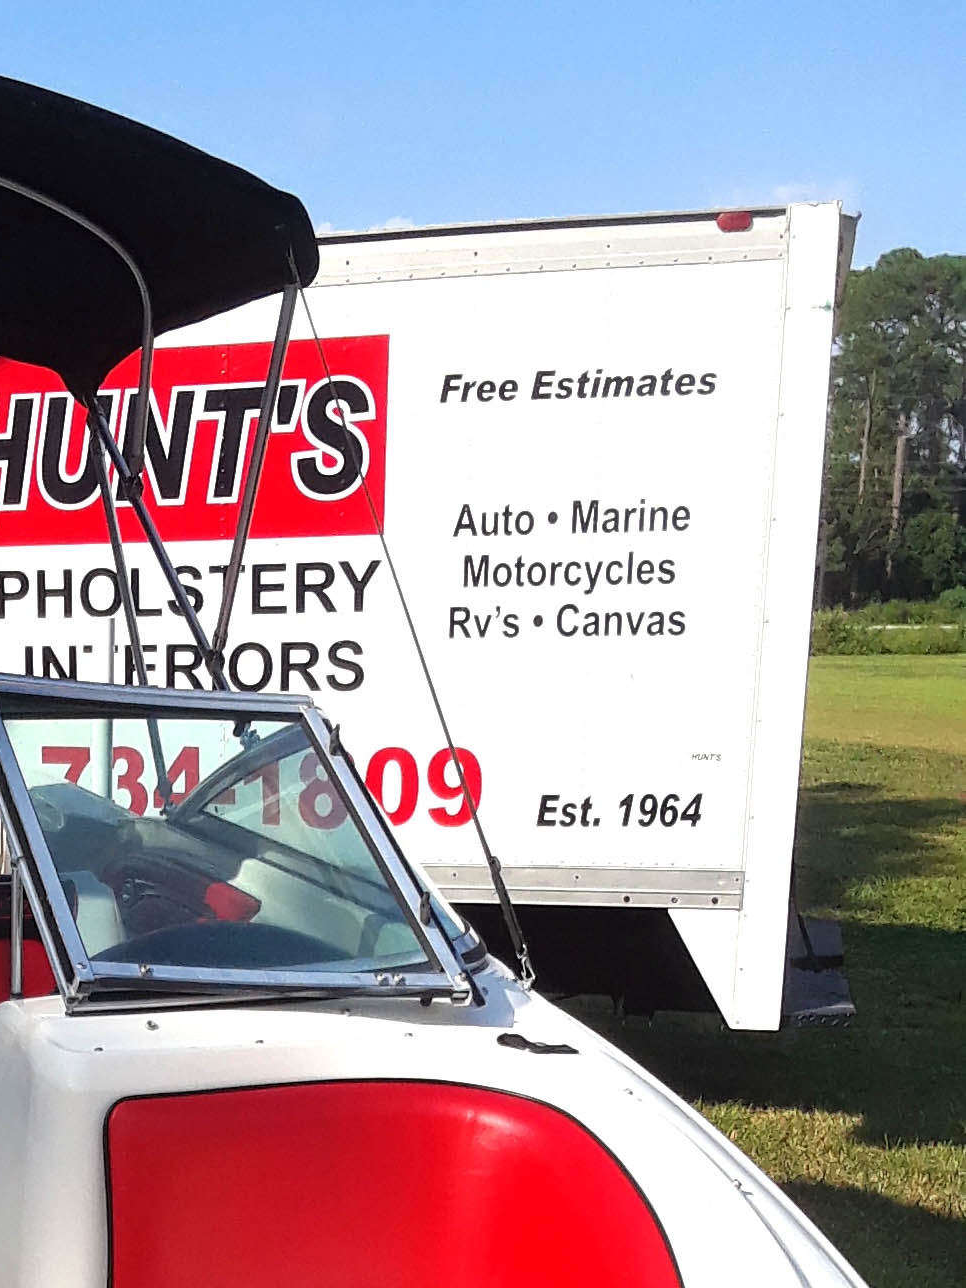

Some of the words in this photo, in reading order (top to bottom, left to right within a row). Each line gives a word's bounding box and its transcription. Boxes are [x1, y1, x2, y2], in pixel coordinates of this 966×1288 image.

[440, 374, 518, 403] Free
[531, 369, 718, 400] Estimates
[453, 504, 534, 537] Auto
[571, 499, 691, 534] Marine
[463, 552, 676, 595] Motorcycles
[448, 606, 520, 638] Rv's
[556, 603, 687, 637] Canvas
[24, 641, 365, 692] INERORS
[536, 794, 601, 827] Est.
[618, 793, 703, 827] 1964
